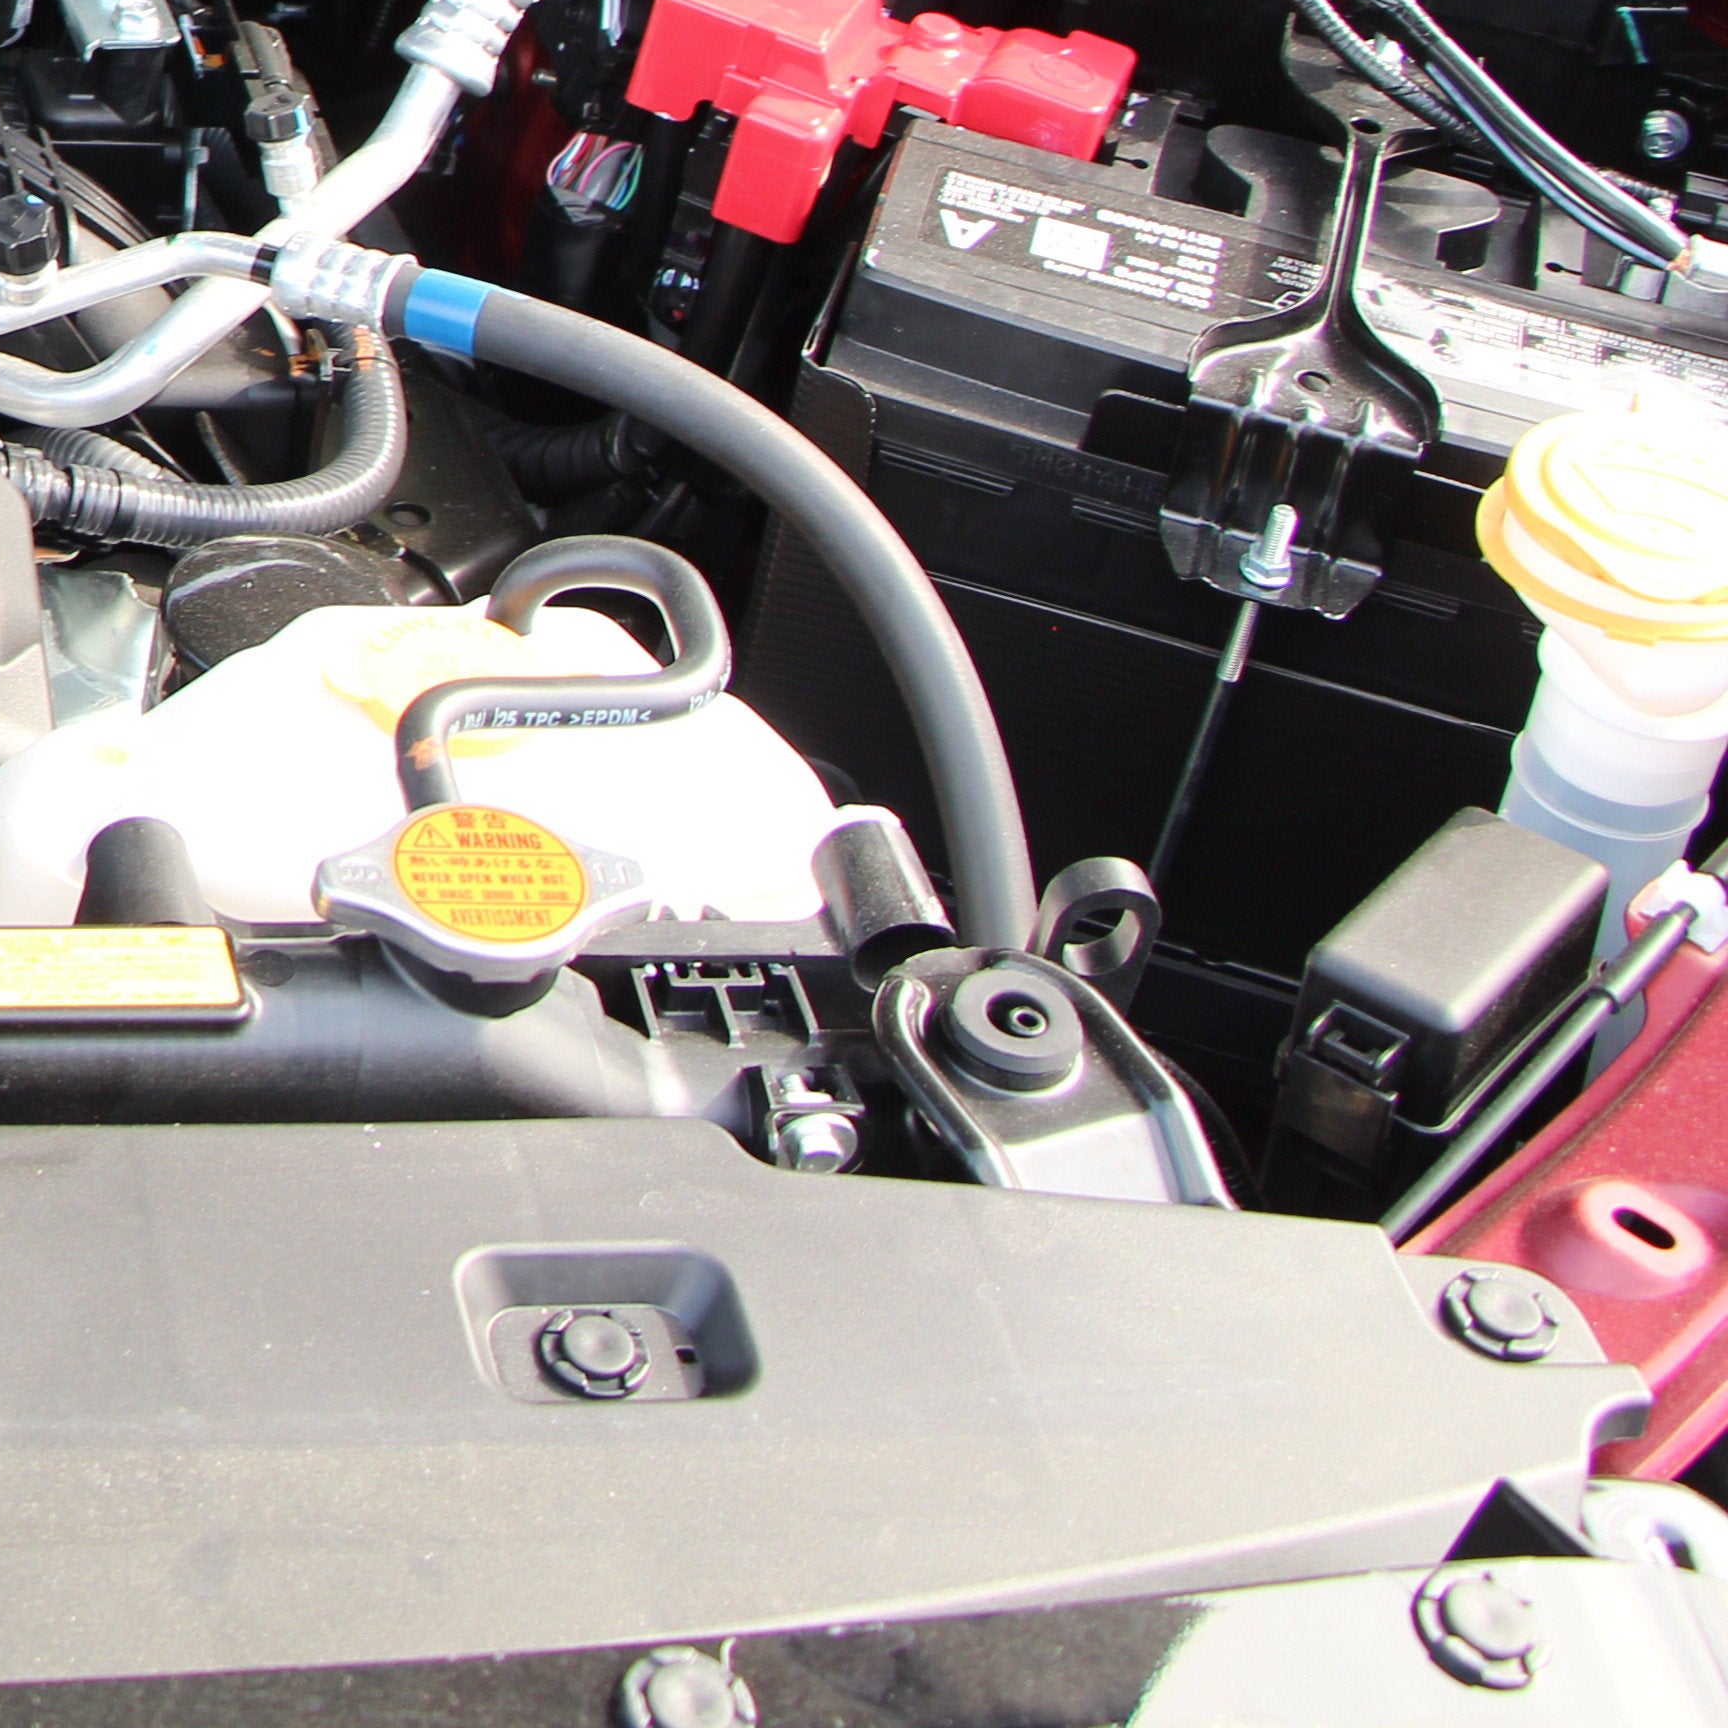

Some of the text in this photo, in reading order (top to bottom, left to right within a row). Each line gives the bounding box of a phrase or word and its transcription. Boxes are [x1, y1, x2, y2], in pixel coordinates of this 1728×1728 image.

[524, 712, 562, 727] TPC
[569, 709, 651, 726] >EPDM<
[455, 832, 542, 849] WARNING
